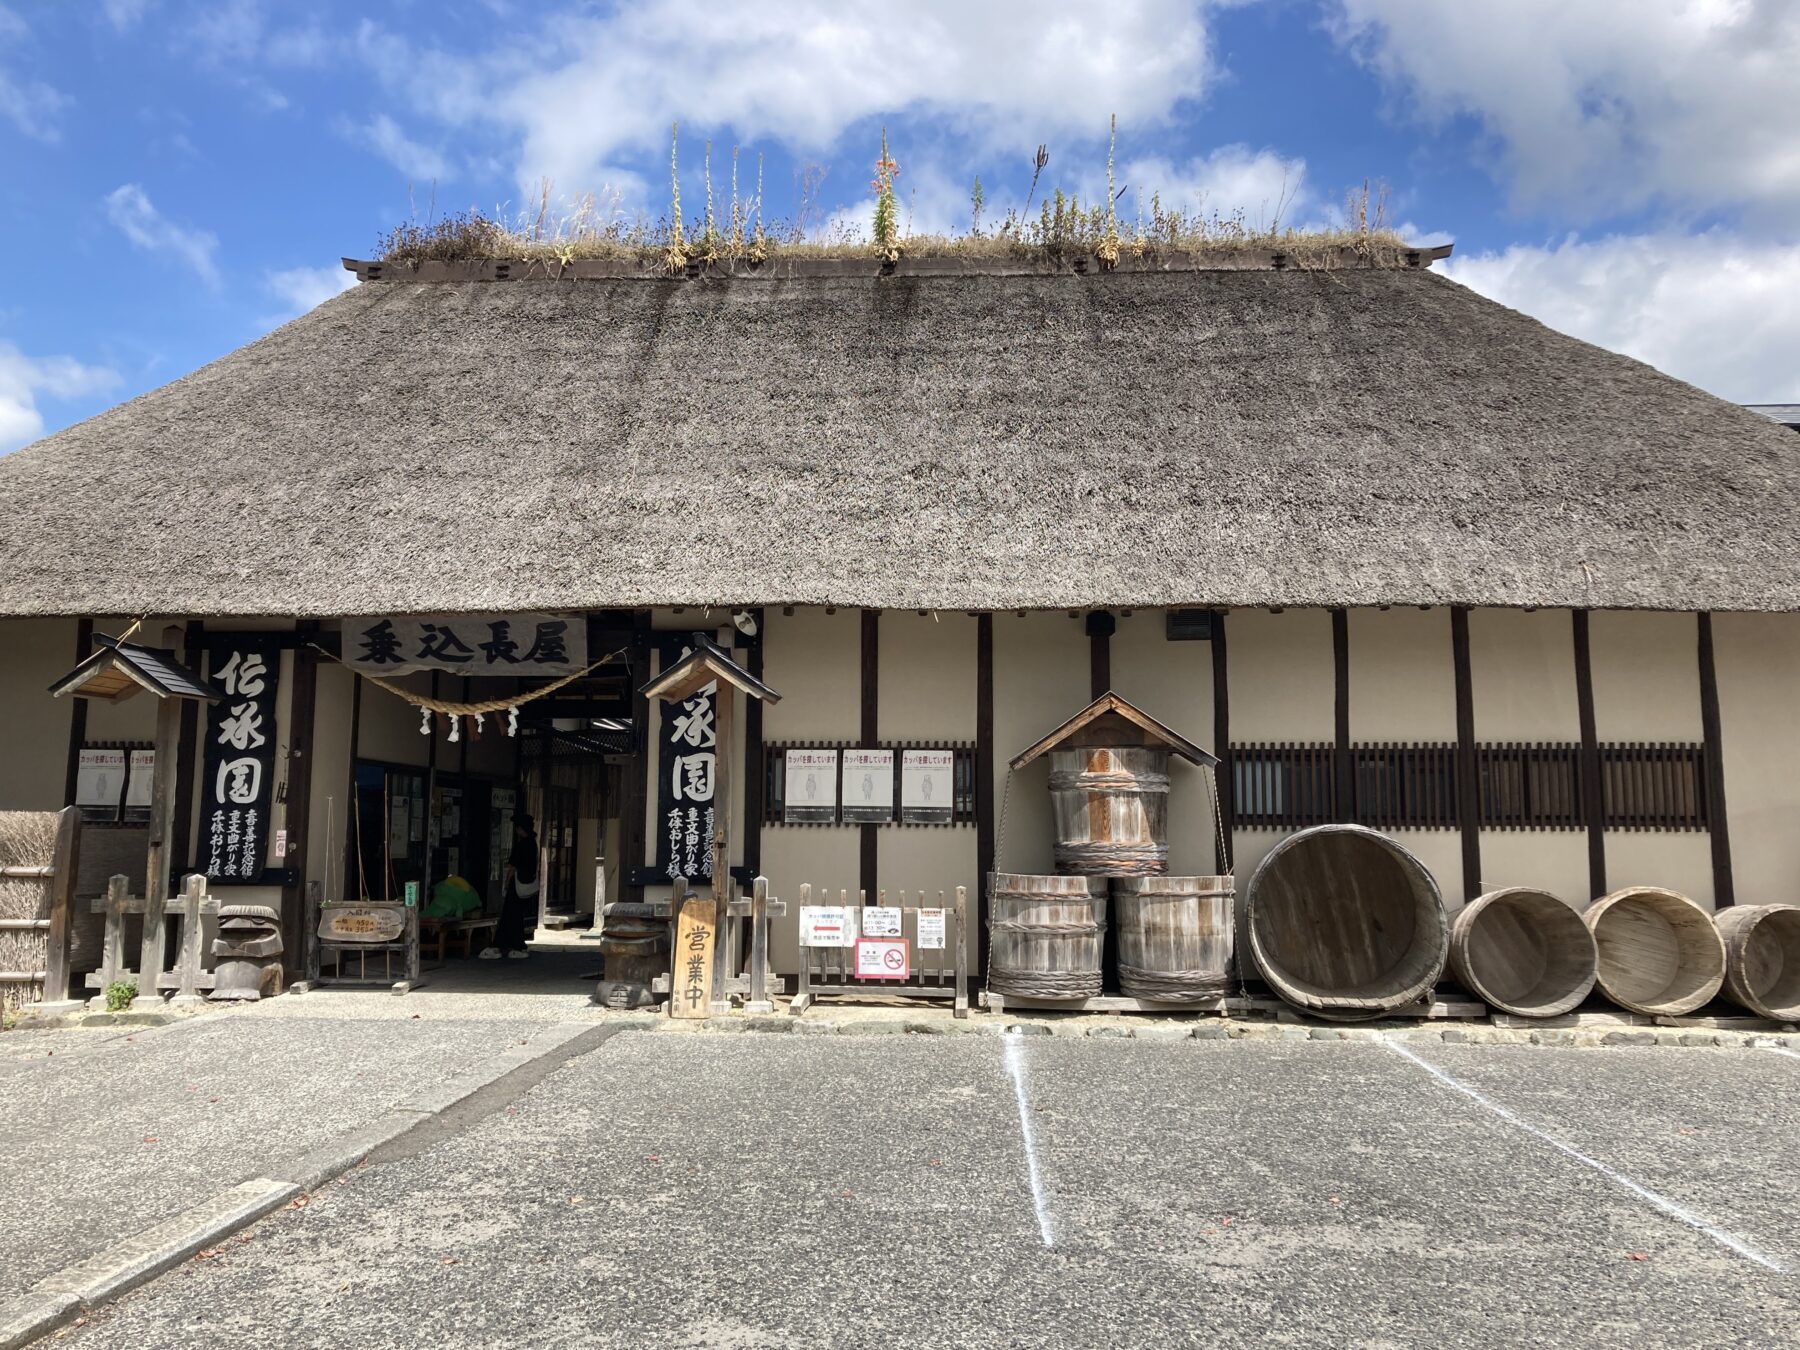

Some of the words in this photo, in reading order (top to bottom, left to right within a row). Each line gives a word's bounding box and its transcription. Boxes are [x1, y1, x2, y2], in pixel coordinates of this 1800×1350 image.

[355, 619, 570, 664] 乗込長屋
[213, 651, 267, 804] 伝承園
[671, 646, 717, 802] 承園
[788, 755, 835, 764] カッパを探しています
[844, 755, 892, 764] カッパを探しています
[904, 756, 951, 765] カッパを探しています
[666, 808, 684, 879] 千体おしら様
[685, 807, 700, 877] 重文曲がり家
[684, 925, 711, 1009] 営業中
